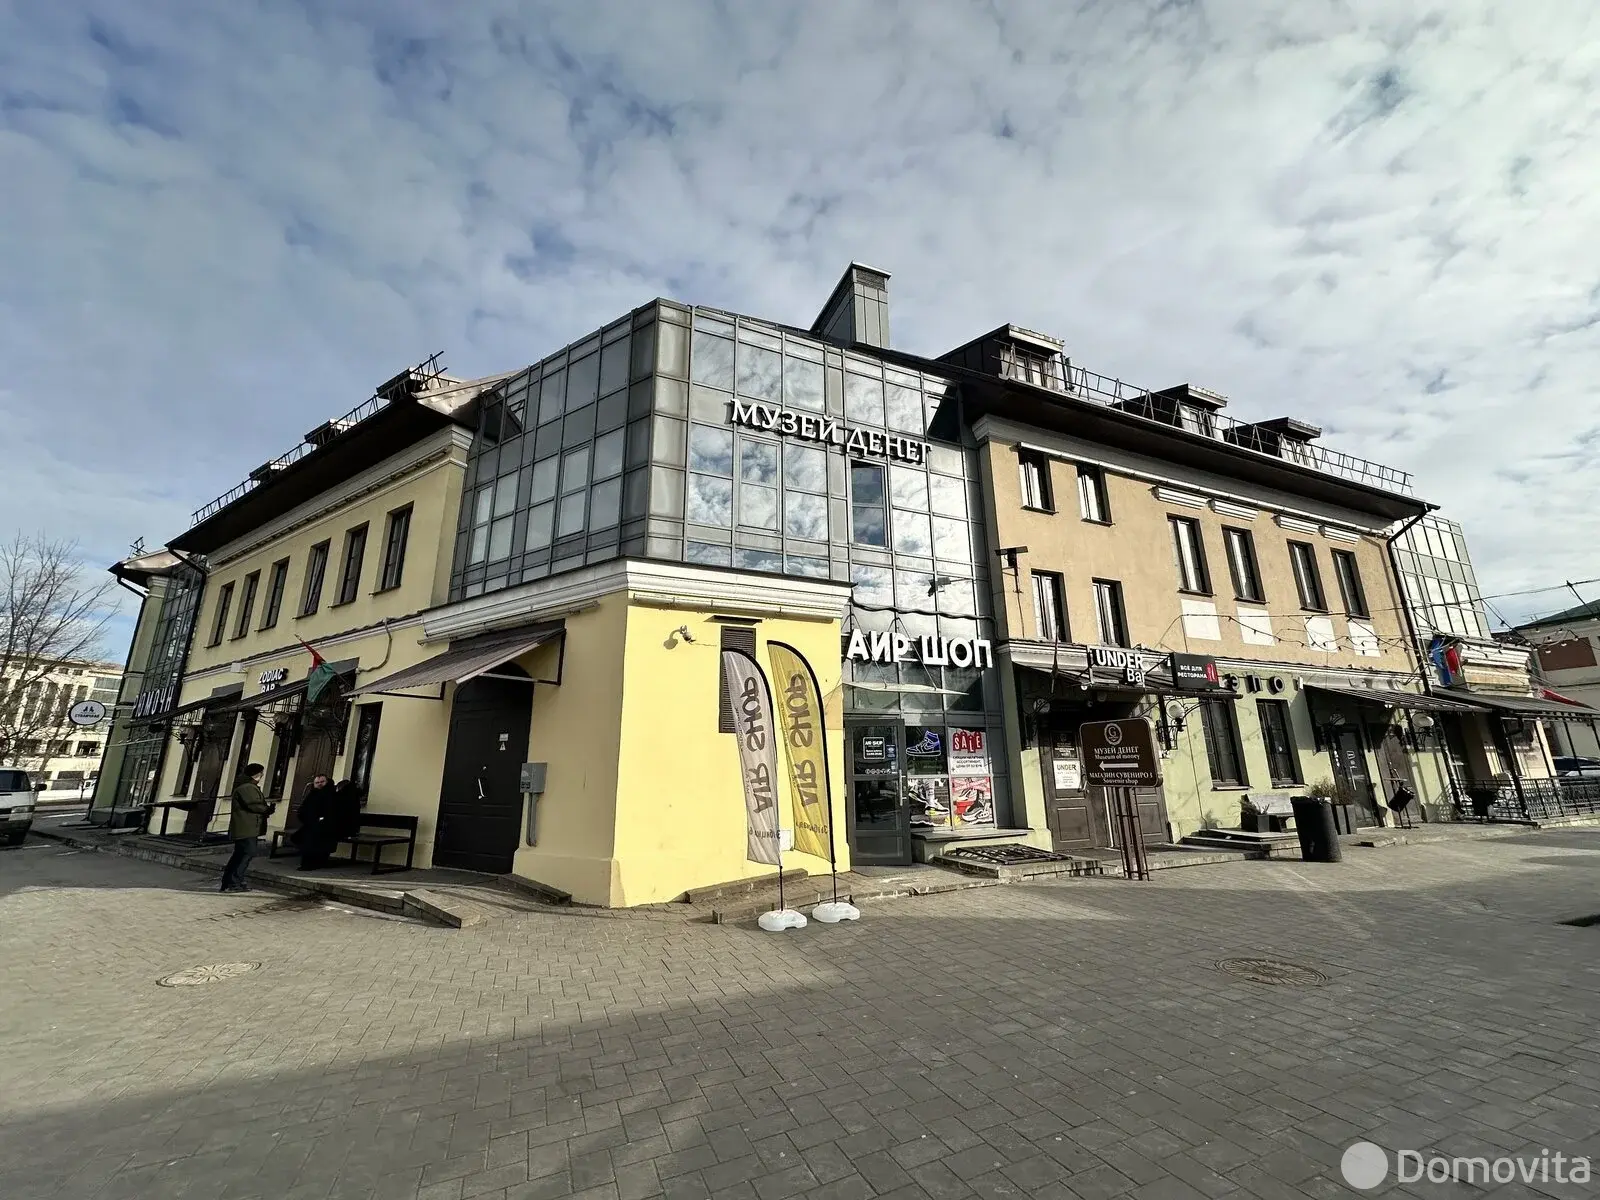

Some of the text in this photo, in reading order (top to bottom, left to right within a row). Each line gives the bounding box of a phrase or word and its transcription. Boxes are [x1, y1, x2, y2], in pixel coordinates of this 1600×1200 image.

[731, 398, 933, 464] МУЗЕЙ ДЕНЕГ
[846, 628, 993, 669] АИР ШОП
[1095, 649, 1143, 669] UNDER
[257, 668, 284, 684] ZODIAC
[1126, 668, 1145, 684] Bar
[1177, 671, 1208, 679] РЕСТОРАНА
[954, 736, 981, 752] SALE
[1093, 746, 1140, 755] МУЗЕЙ ДЕНЕГ
[1089, 771, 1115, 779] МАГАЗИН
